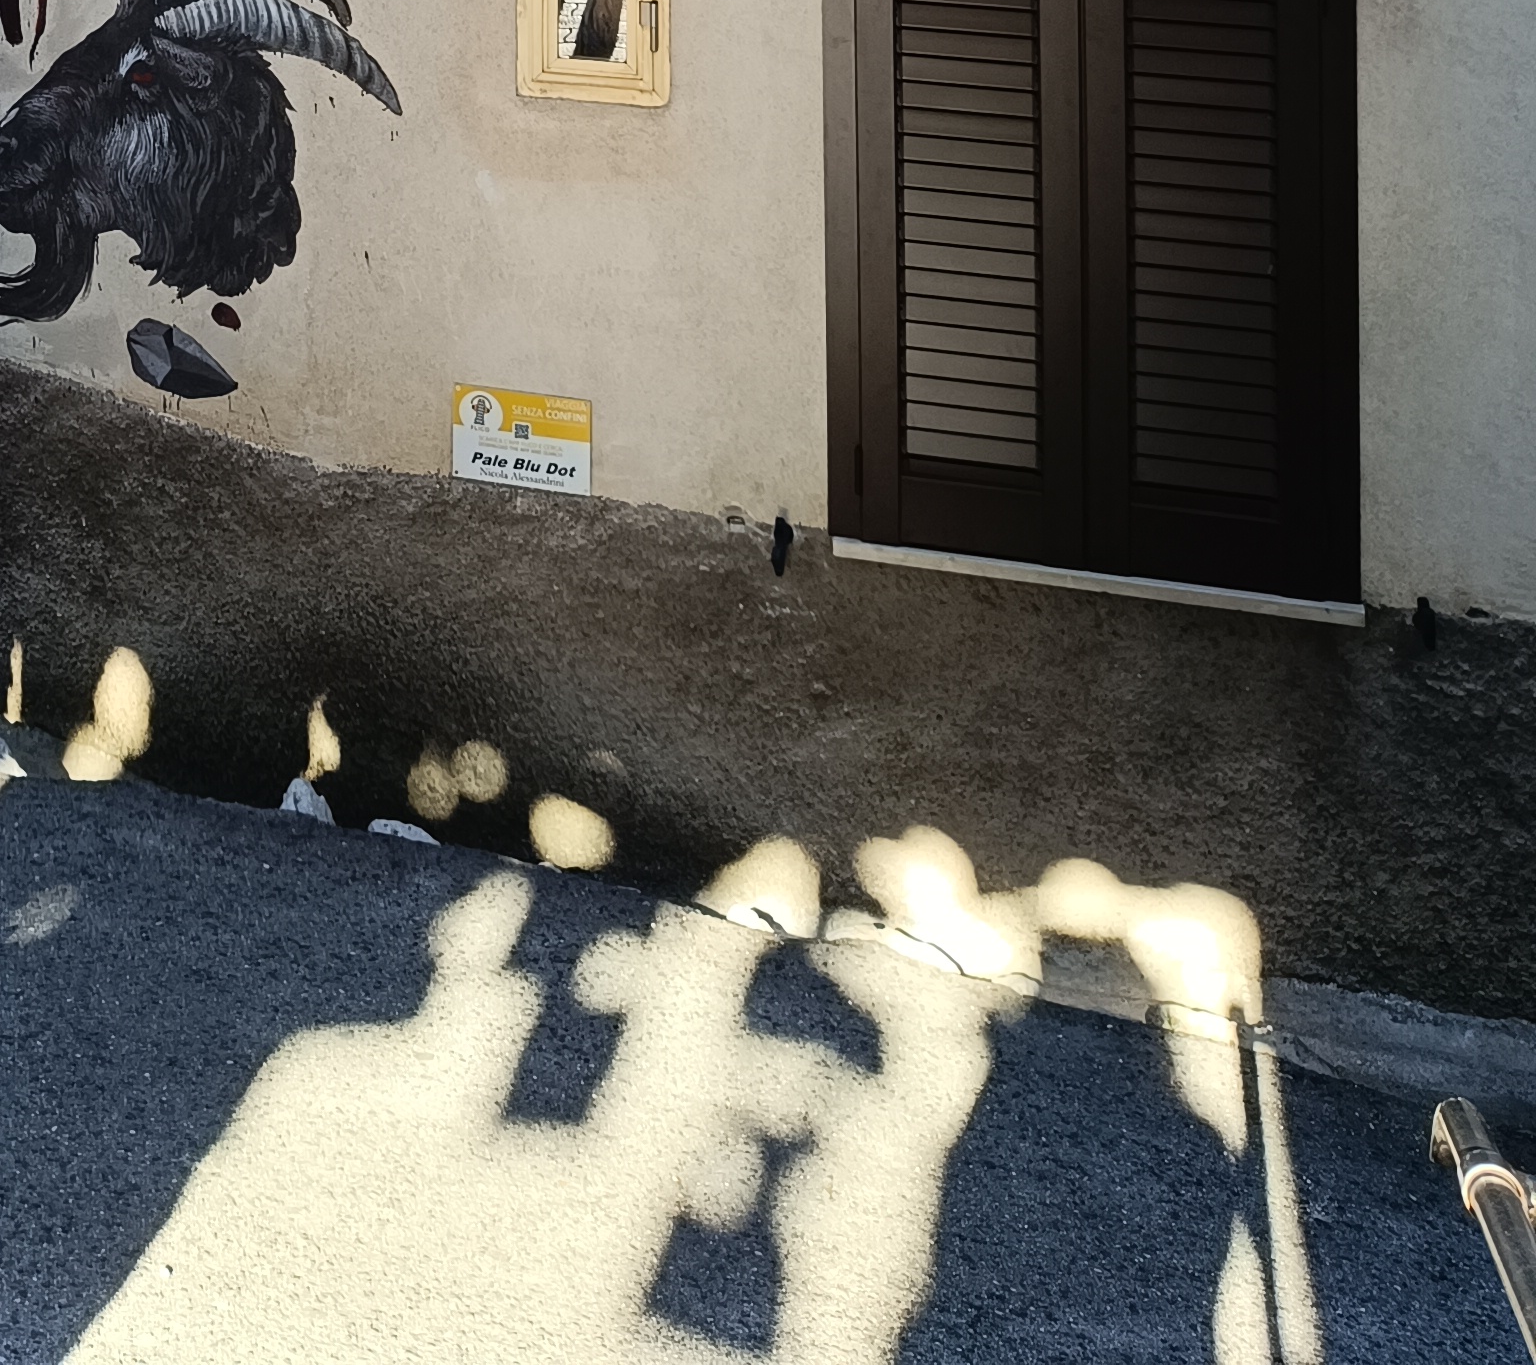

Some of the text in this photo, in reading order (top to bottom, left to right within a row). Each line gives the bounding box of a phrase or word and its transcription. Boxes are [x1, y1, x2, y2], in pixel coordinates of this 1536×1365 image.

[545, 398, 587, 411] VIAGGIA
[512, 406, 587, 422] SENZA CONFINI
[471, 452, 576, 477] Pale Blu Dot
[480, 467, 564, 487] Nicola Alessandrini
